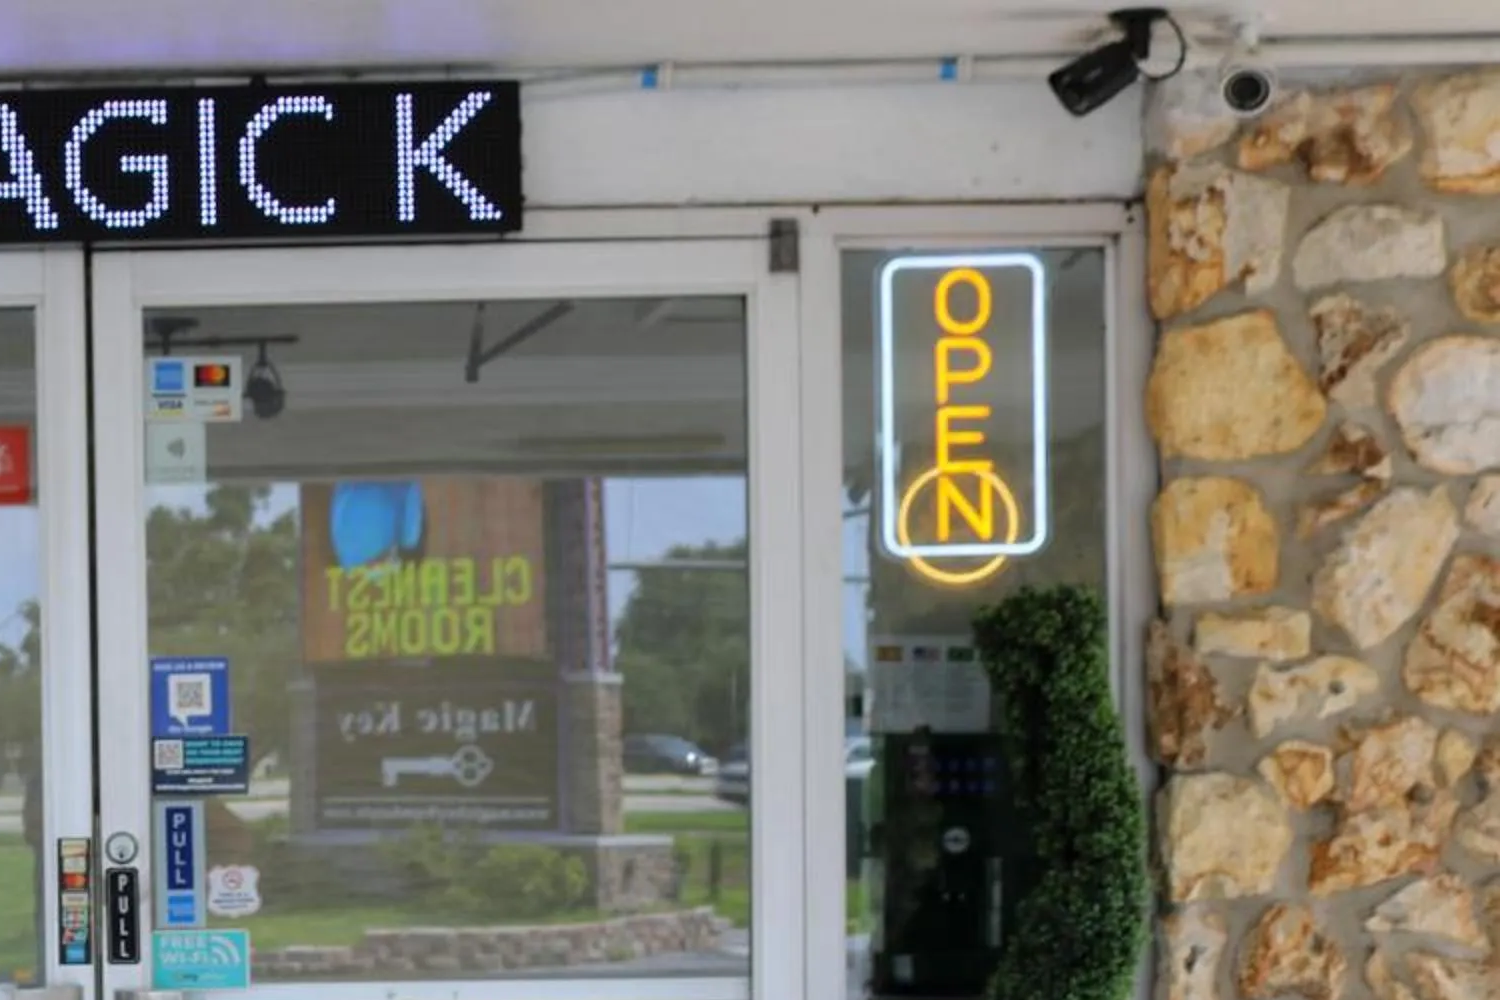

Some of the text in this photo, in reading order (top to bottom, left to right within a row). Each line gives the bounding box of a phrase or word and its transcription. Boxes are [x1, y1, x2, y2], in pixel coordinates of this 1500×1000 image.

[396, 90, 502, 222] K
[934, 266, 993, 543] OPEN
[172, 812, 187, 885] PULL
[118, 873, 131, 958] PULL
